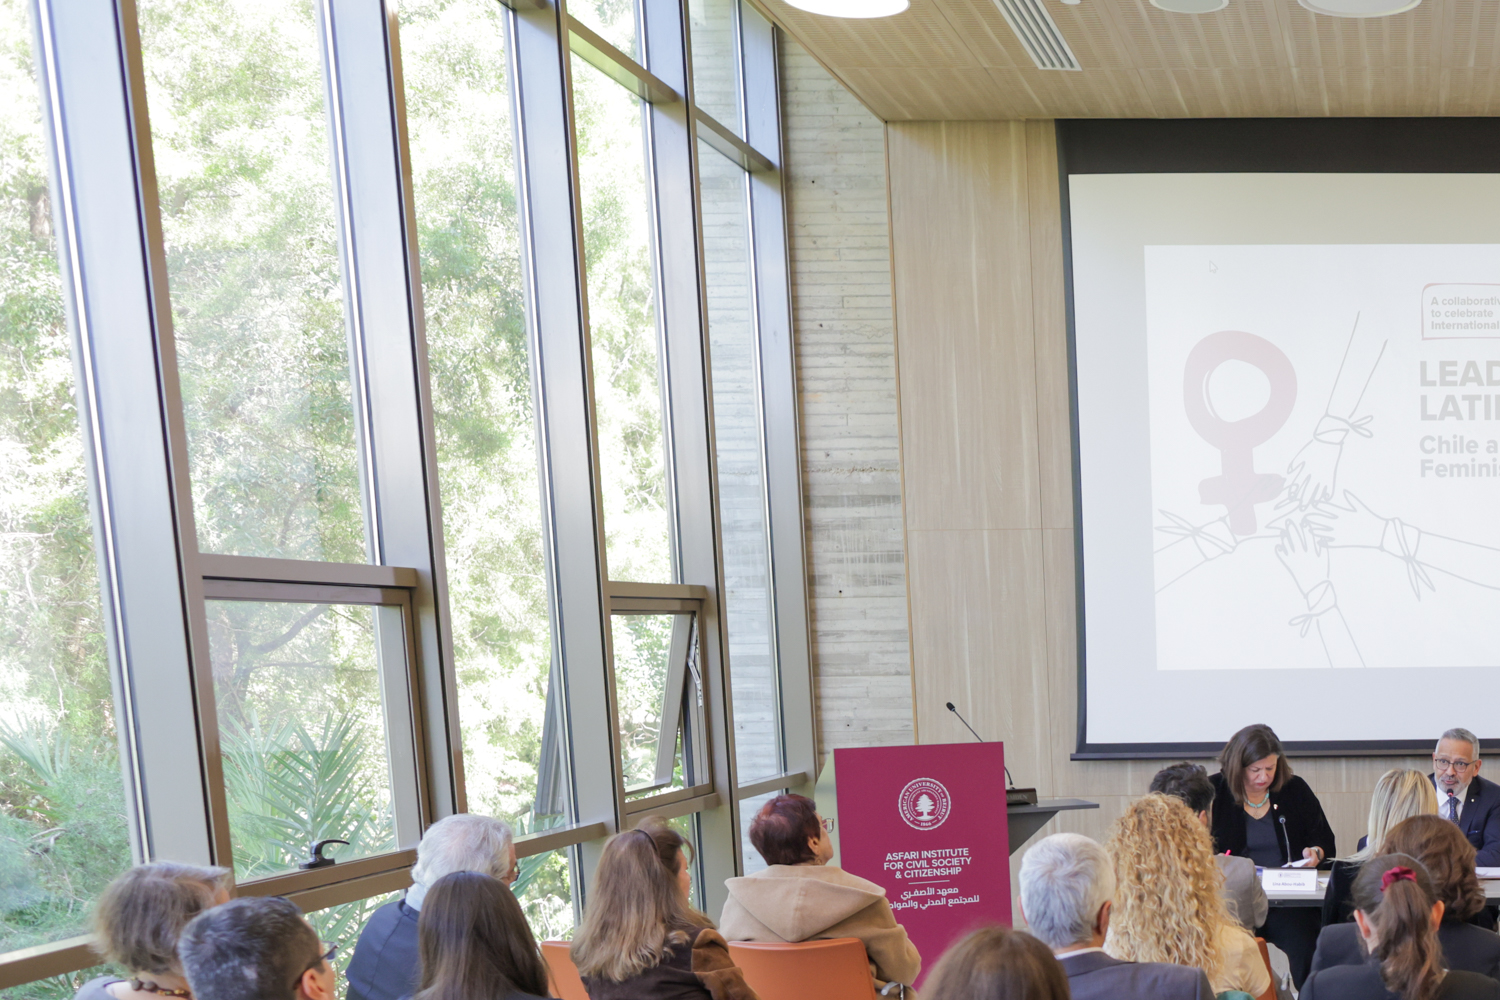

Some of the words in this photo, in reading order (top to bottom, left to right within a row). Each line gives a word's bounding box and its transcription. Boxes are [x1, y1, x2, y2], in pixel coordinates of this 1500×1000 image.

[1431, 297, 1440, 306] A
[1431, 308, 1442, 318] to
[1444, 308, 1494, 318] celebrate
[1431, 320, 1500, 330] International
[1419, 434, 1479, 454] Chile
[885, 851, 919, 861] ASFARI
[921, 848, 969, 858] INSTITUTE
[883, 861, 904, 871] FOR
[905, 860, 930, 869] CIVIL
[931, 857, 972, 867] SOCIETY
[895, 870, 902, 879] &
[903, 867, 962, 878] CITIZENSHIP
[900, 887, 935, 901] الأصفري
[936, 887, 959, 896] معهد
[919, 897, 946, 910] المدني
[947, 895, 980, 907] للمجتمع
